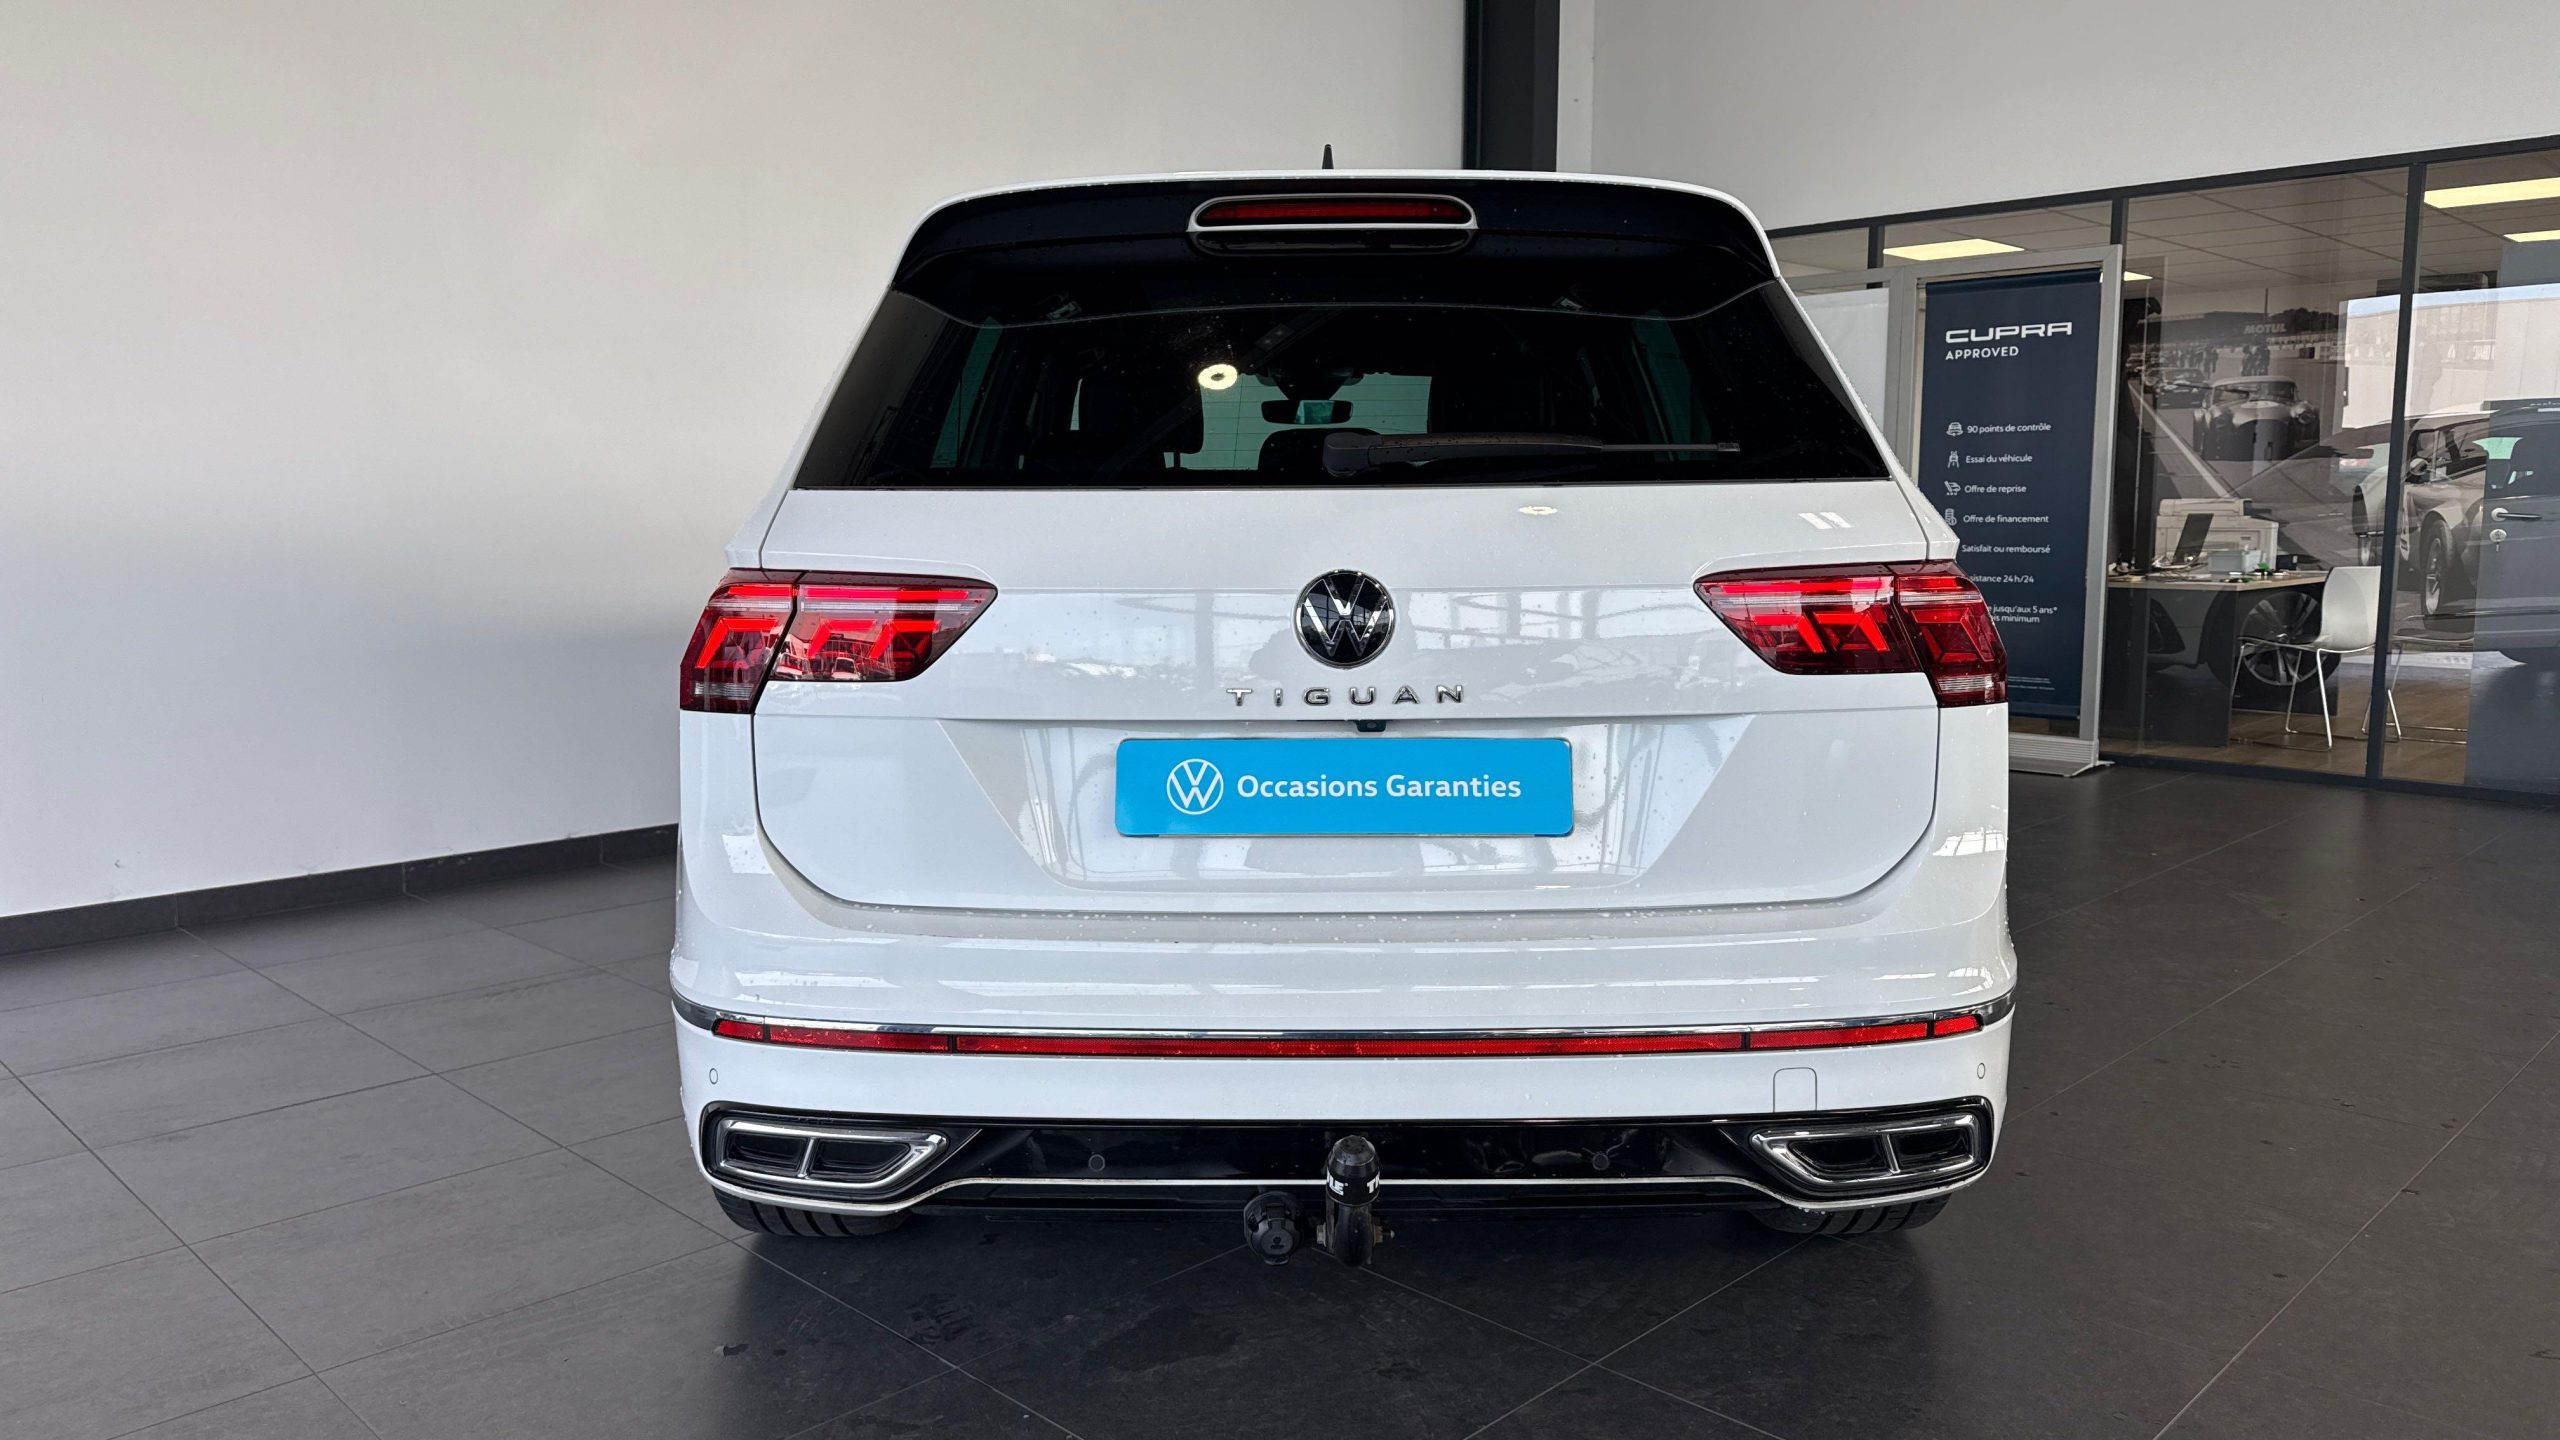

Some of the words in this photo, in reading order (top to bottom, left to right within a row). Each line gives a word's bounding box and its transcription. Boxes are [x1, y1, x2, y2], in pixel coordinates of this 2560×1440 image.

[1945, 321, 2073, 344] CUPRA
[1945, 346, 2019, 360] APPROVED
[1967, 425, 1978, 433] 90
[1979, 425, 2004, 434] points
[2005, 424, 2016, 432] de
[2017, 422, 2052, 432] contrôle
[1965, 454, 1986, 464] Essai
[1986, 454, 1997, 463] du
[1998, 453, 2033, 462] véhicule
[1964, 485, 1985, 493] Offre
[1986, 485, 1998, 493] de
[1998, 484, 2027, 494] reprise
[1963, 515, 1984, 523] Offre
[1984, 515, 1996, 523] de
[1997, 514, 2049, 523] financement
[1961, 544, 1992, 553] Satisfait
[1993, 545, 2005, 553] ou
[2006, 545, 2051, 554] remboursé
[1993, 604, 2031, 613] jusqu'aux
[2032, 605, 2038, 613] 5
[2001, 615, 2040, 623] minimum
[1226, 685, 1464, 707] TIGUAN
[1236, 774, 1378, 799] Occasions
[1385, 774, 1522, 799] Garanties
